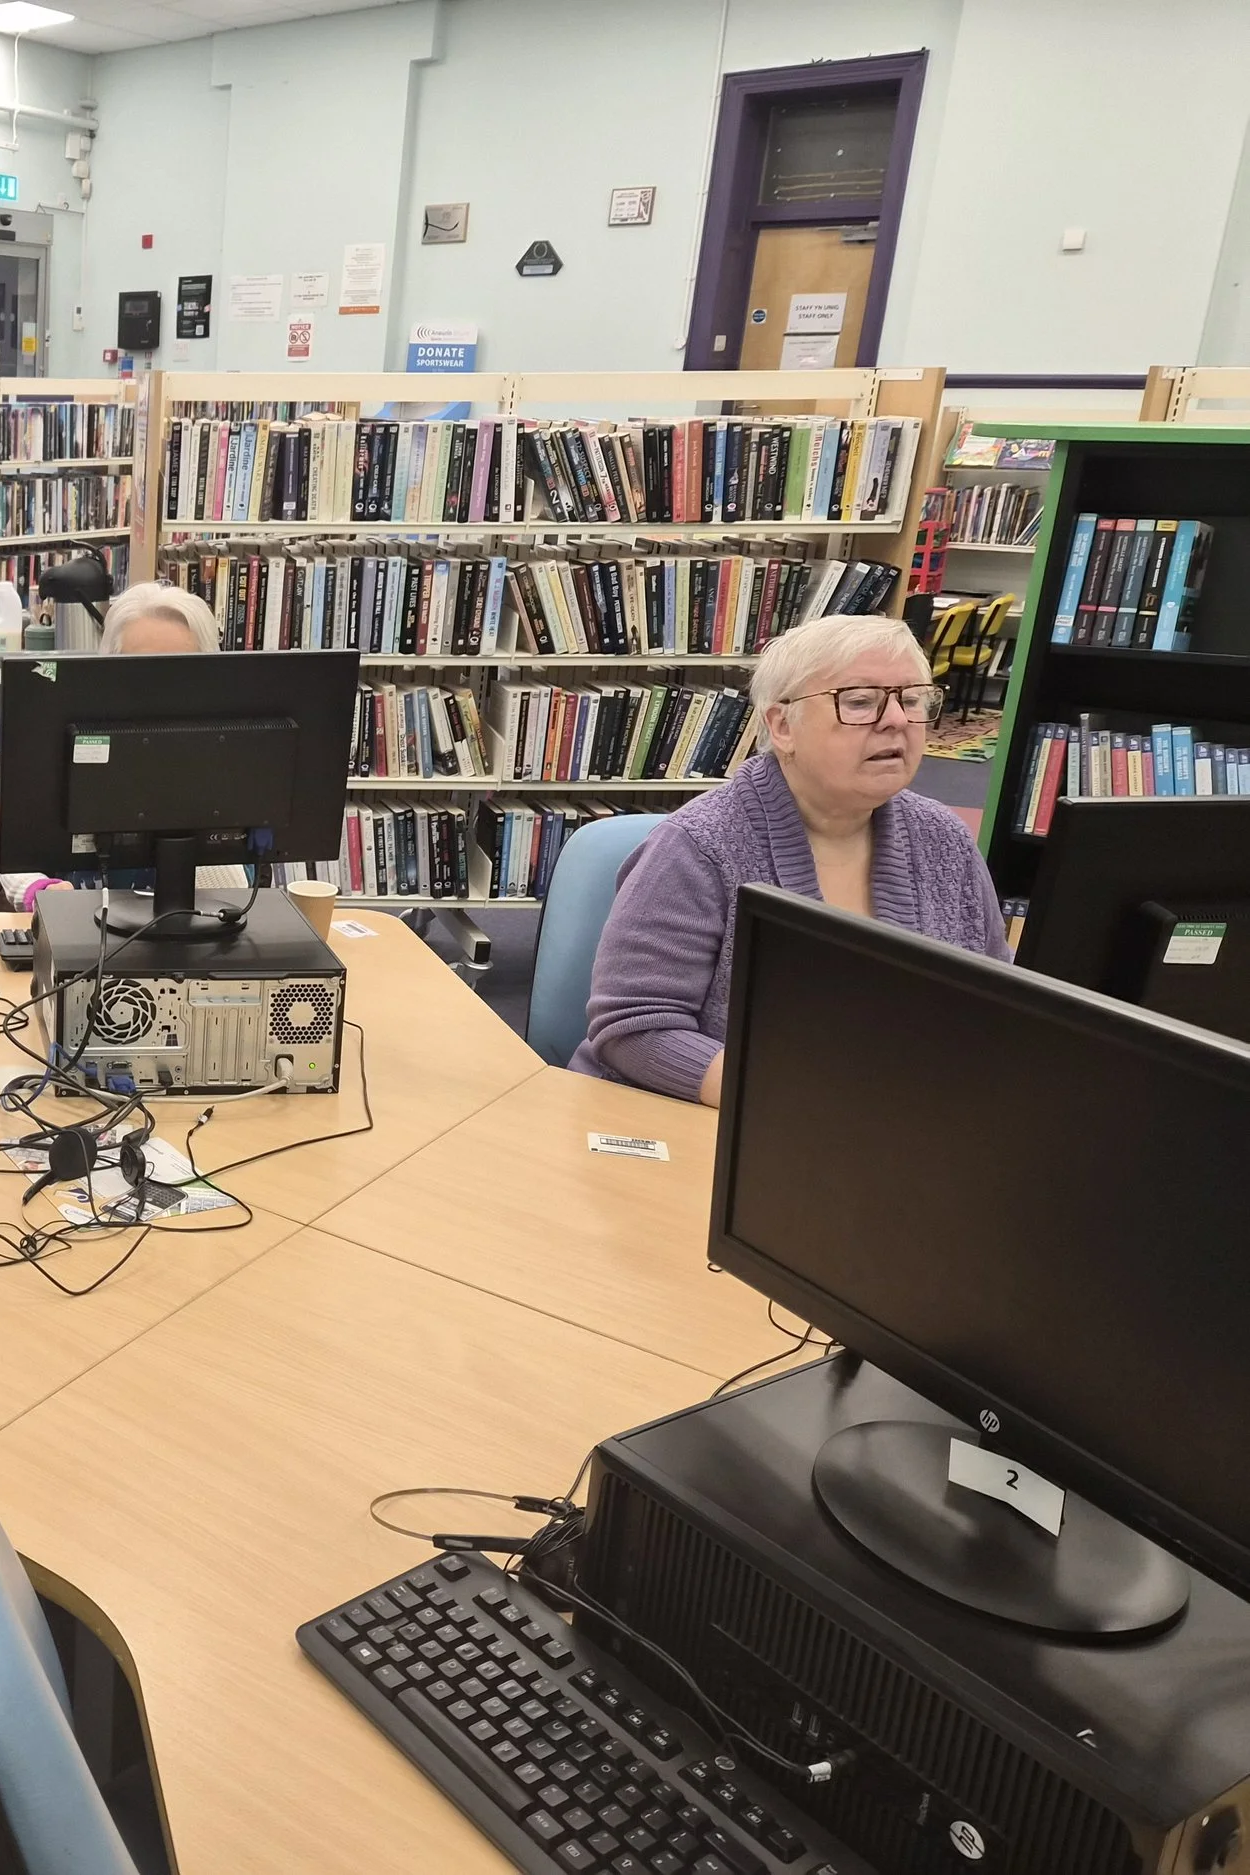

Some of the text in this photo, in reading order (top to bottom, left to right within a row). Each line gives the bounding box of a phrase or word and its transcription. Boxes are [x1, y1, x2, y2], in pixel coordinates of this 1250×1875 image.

[417, 346, 466, 358] DONATE
[415, 358, 465, 368] SPORTSWEAR
[1184, 928, 1213, 936] PASSED
[980, 1409, 1000, 1433] hp
[1005, 1468, 1020, 1491] 2
